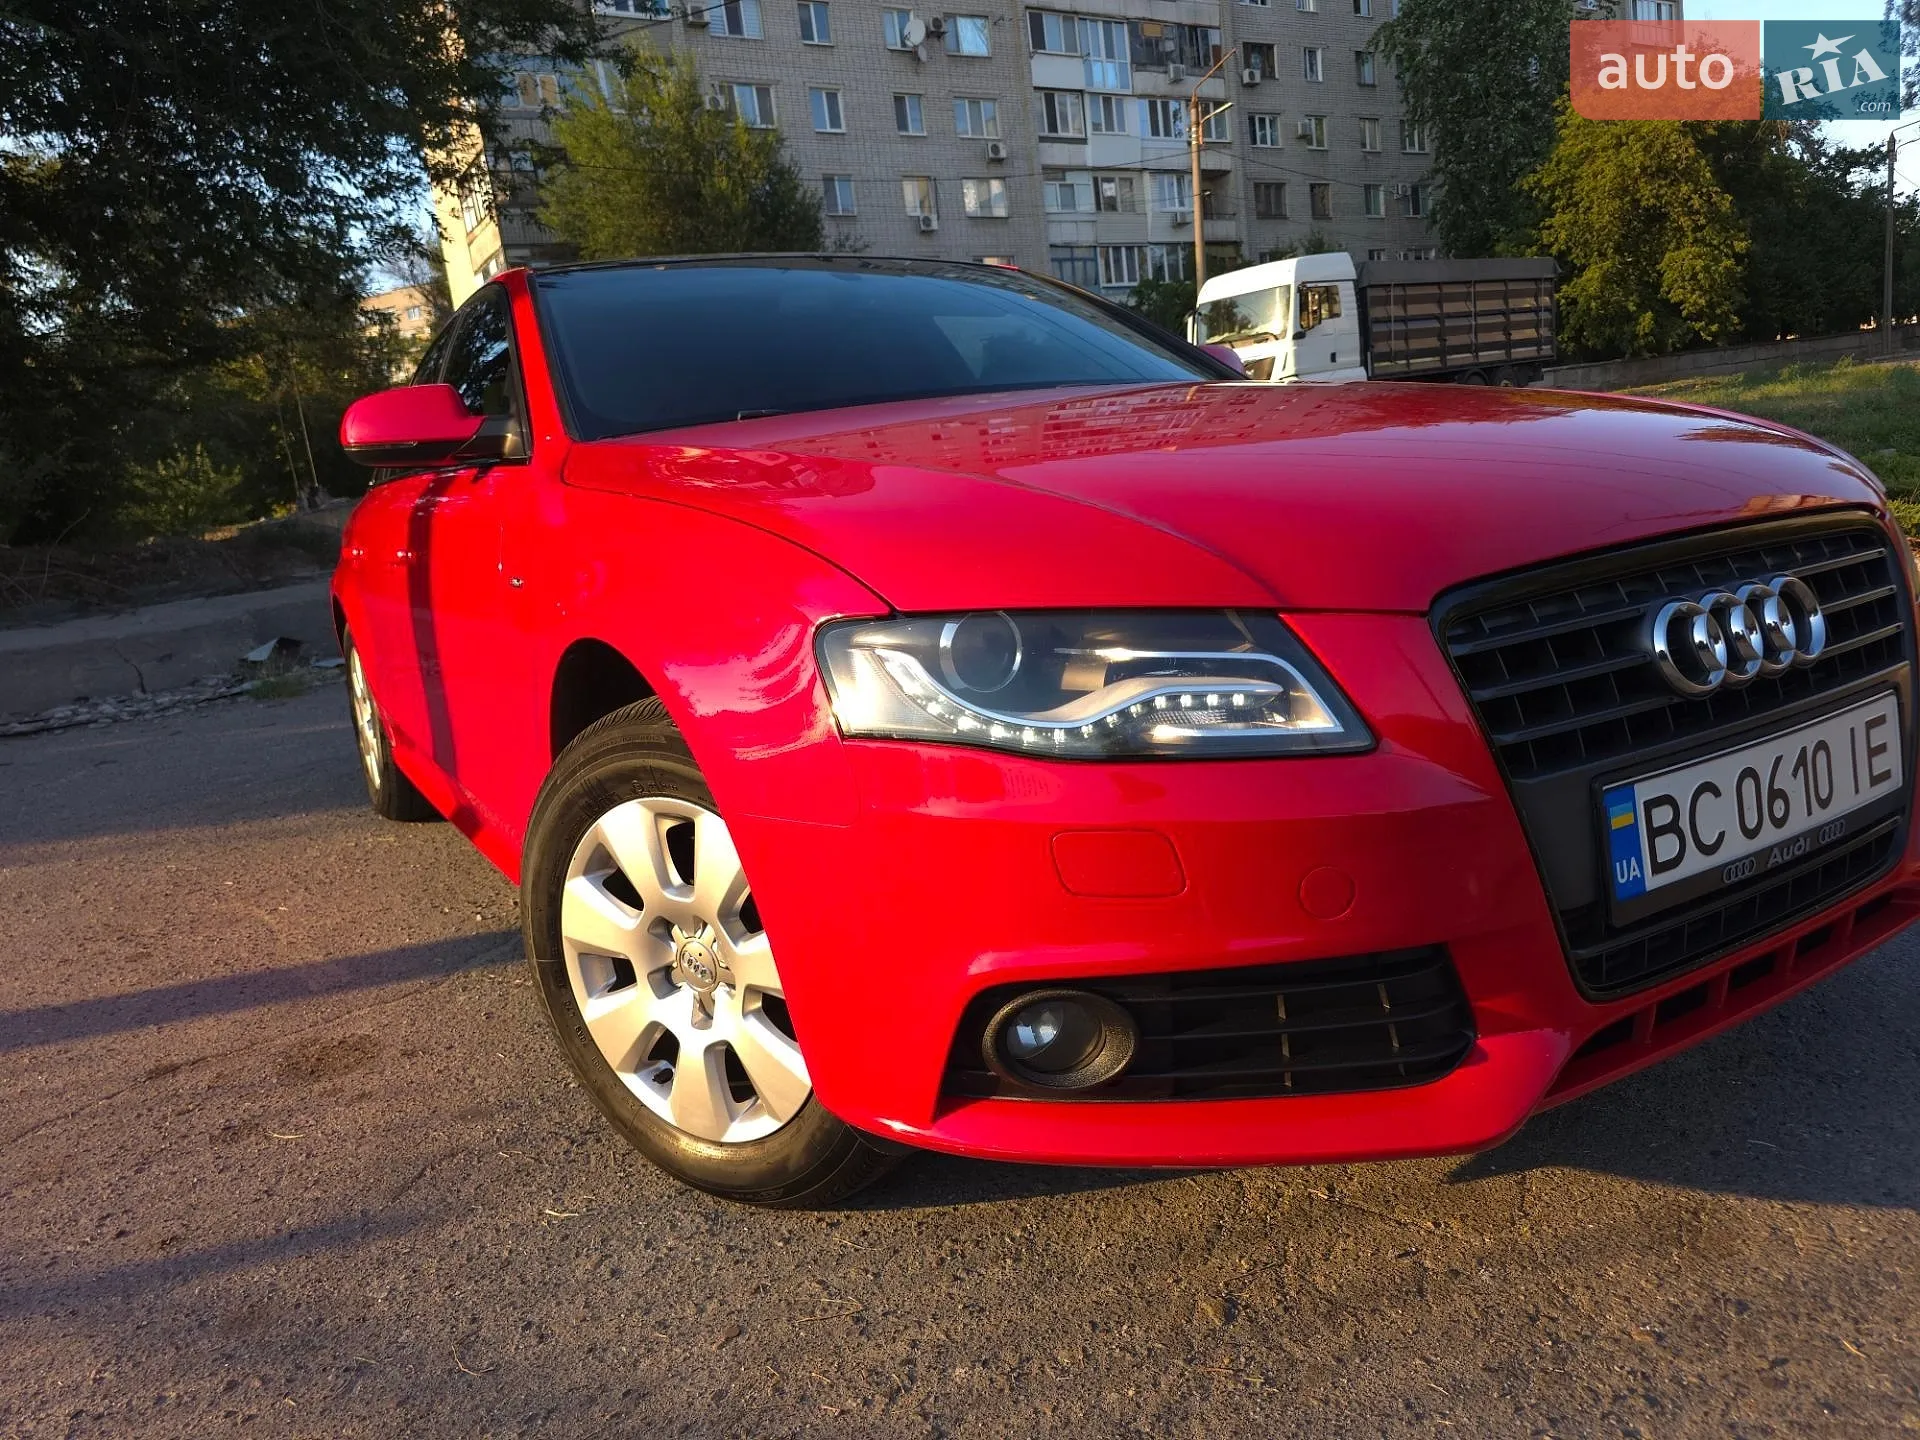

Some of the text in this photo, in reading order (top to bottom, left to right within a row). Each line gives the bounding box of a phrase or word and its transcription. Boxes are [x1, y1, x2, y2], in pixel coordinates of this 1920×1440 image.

[1643, 712, 1892, 877] BC 0610 IE
[1767, 837, 1811, 869] Audi
[1616, 856, 1642, 884] UA
